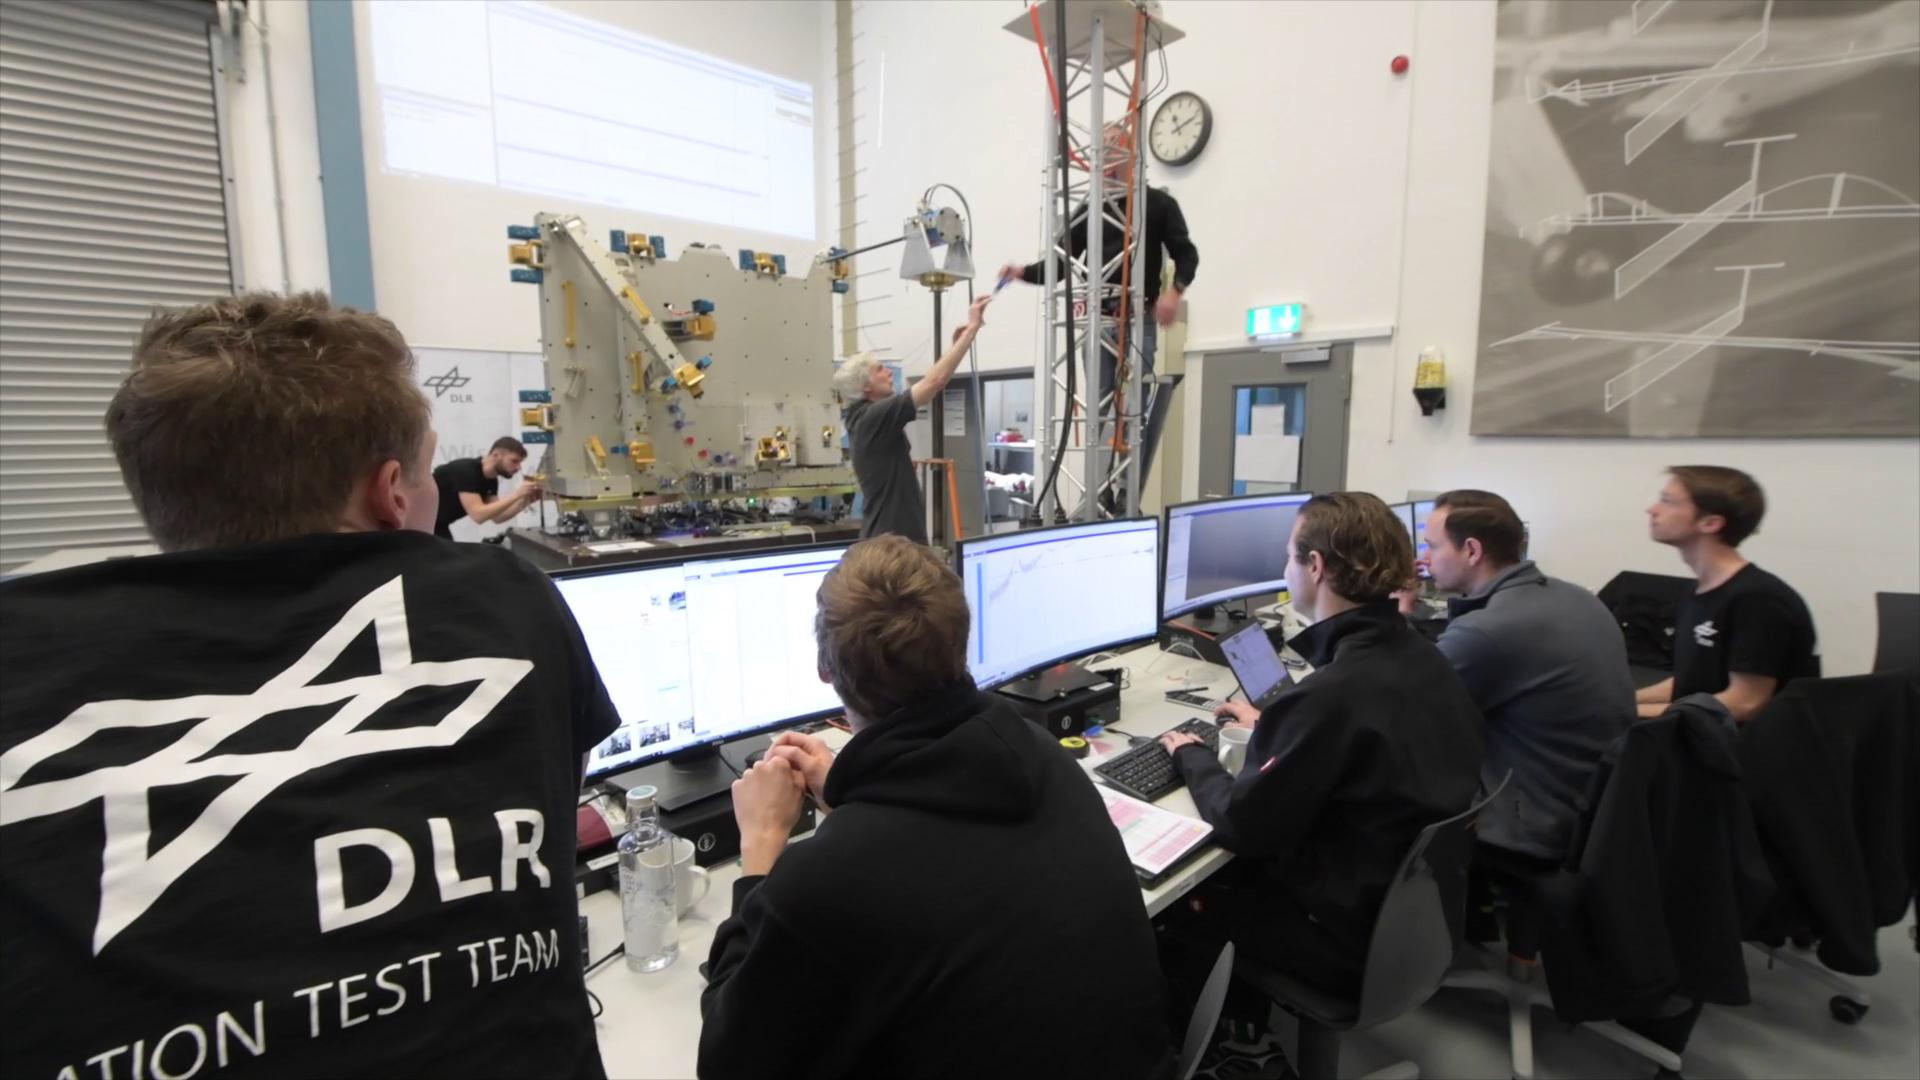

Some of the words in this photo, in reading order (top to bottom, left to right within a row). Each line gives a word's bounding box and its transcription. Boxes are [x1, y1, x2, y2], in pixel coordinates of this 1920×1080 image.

[450, 393, 474, 404] DLR
[313, 808, 551, 934] DLR
[293, 951, 442, 1038] TEST
[457, 928, 560, 988] TEAM
